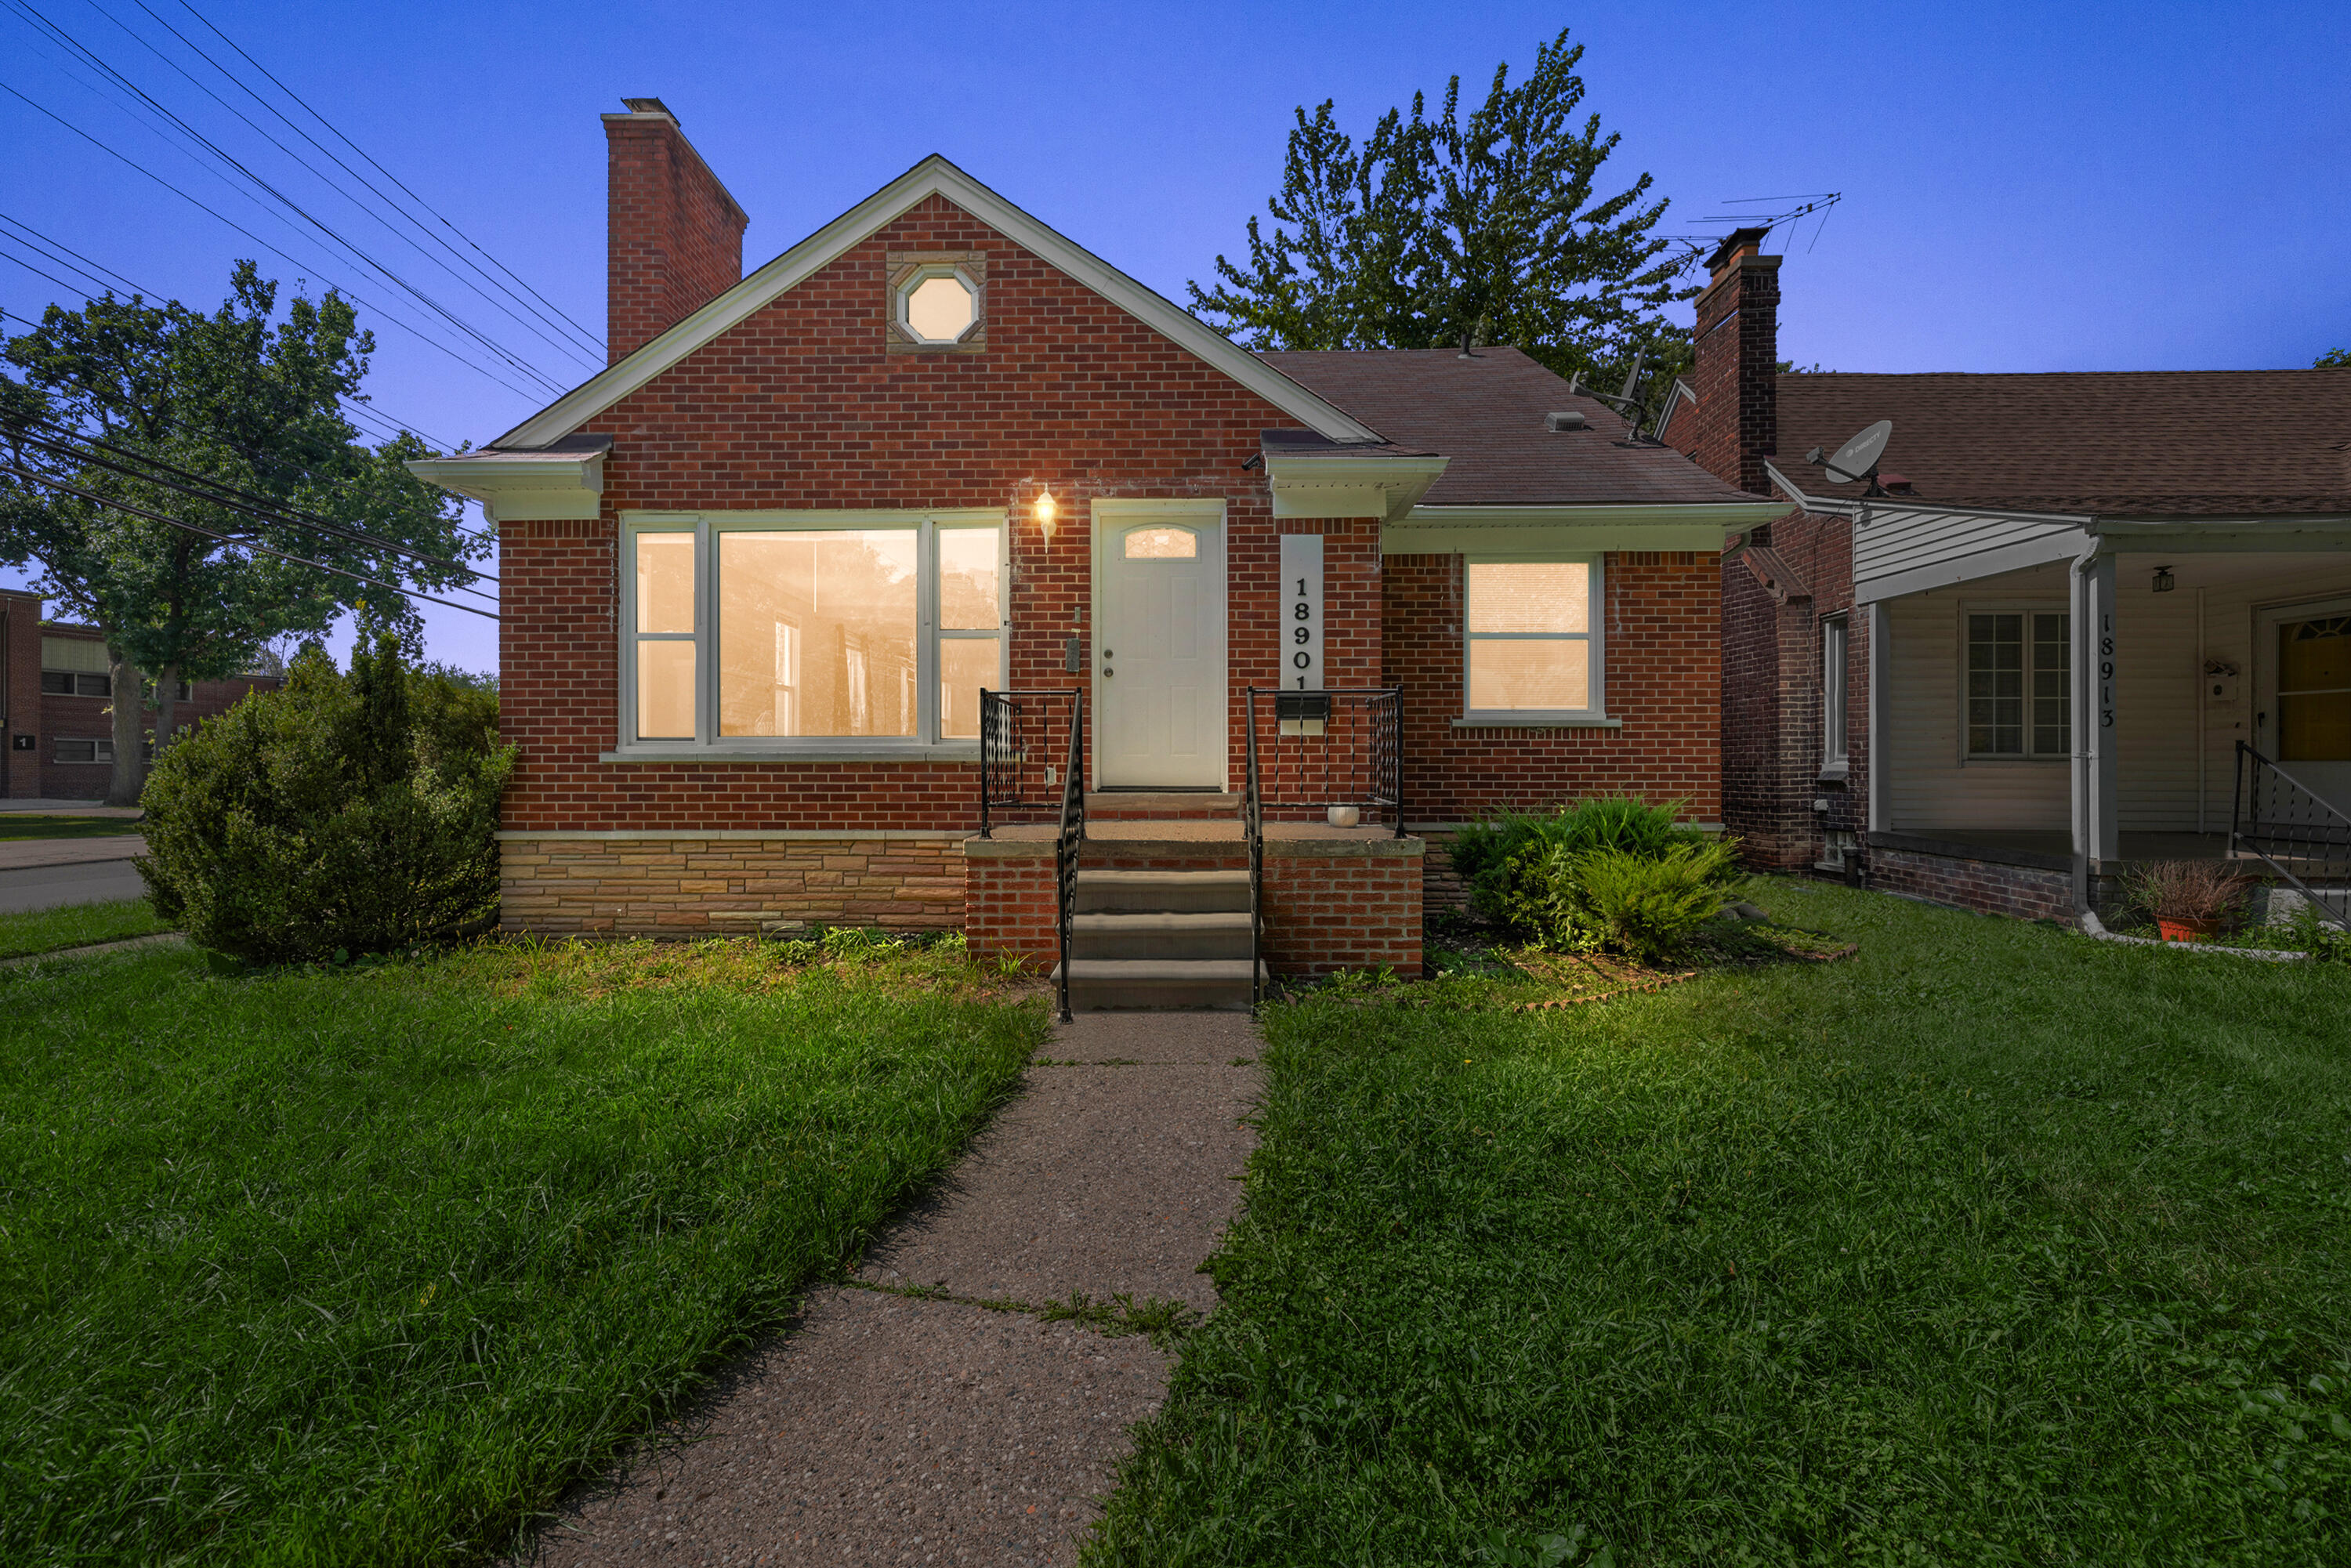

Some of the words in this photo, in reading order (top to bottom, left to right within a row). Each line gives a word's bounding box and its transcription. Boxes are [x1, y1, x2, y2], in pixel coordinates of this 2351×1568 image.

[1855, 430, 1881, 453] DIRECTV
[1293, 578, 1311, 690] 18901
[2101, 614, 2114, 728] 18913
[19, 737, 26, 747] 1
